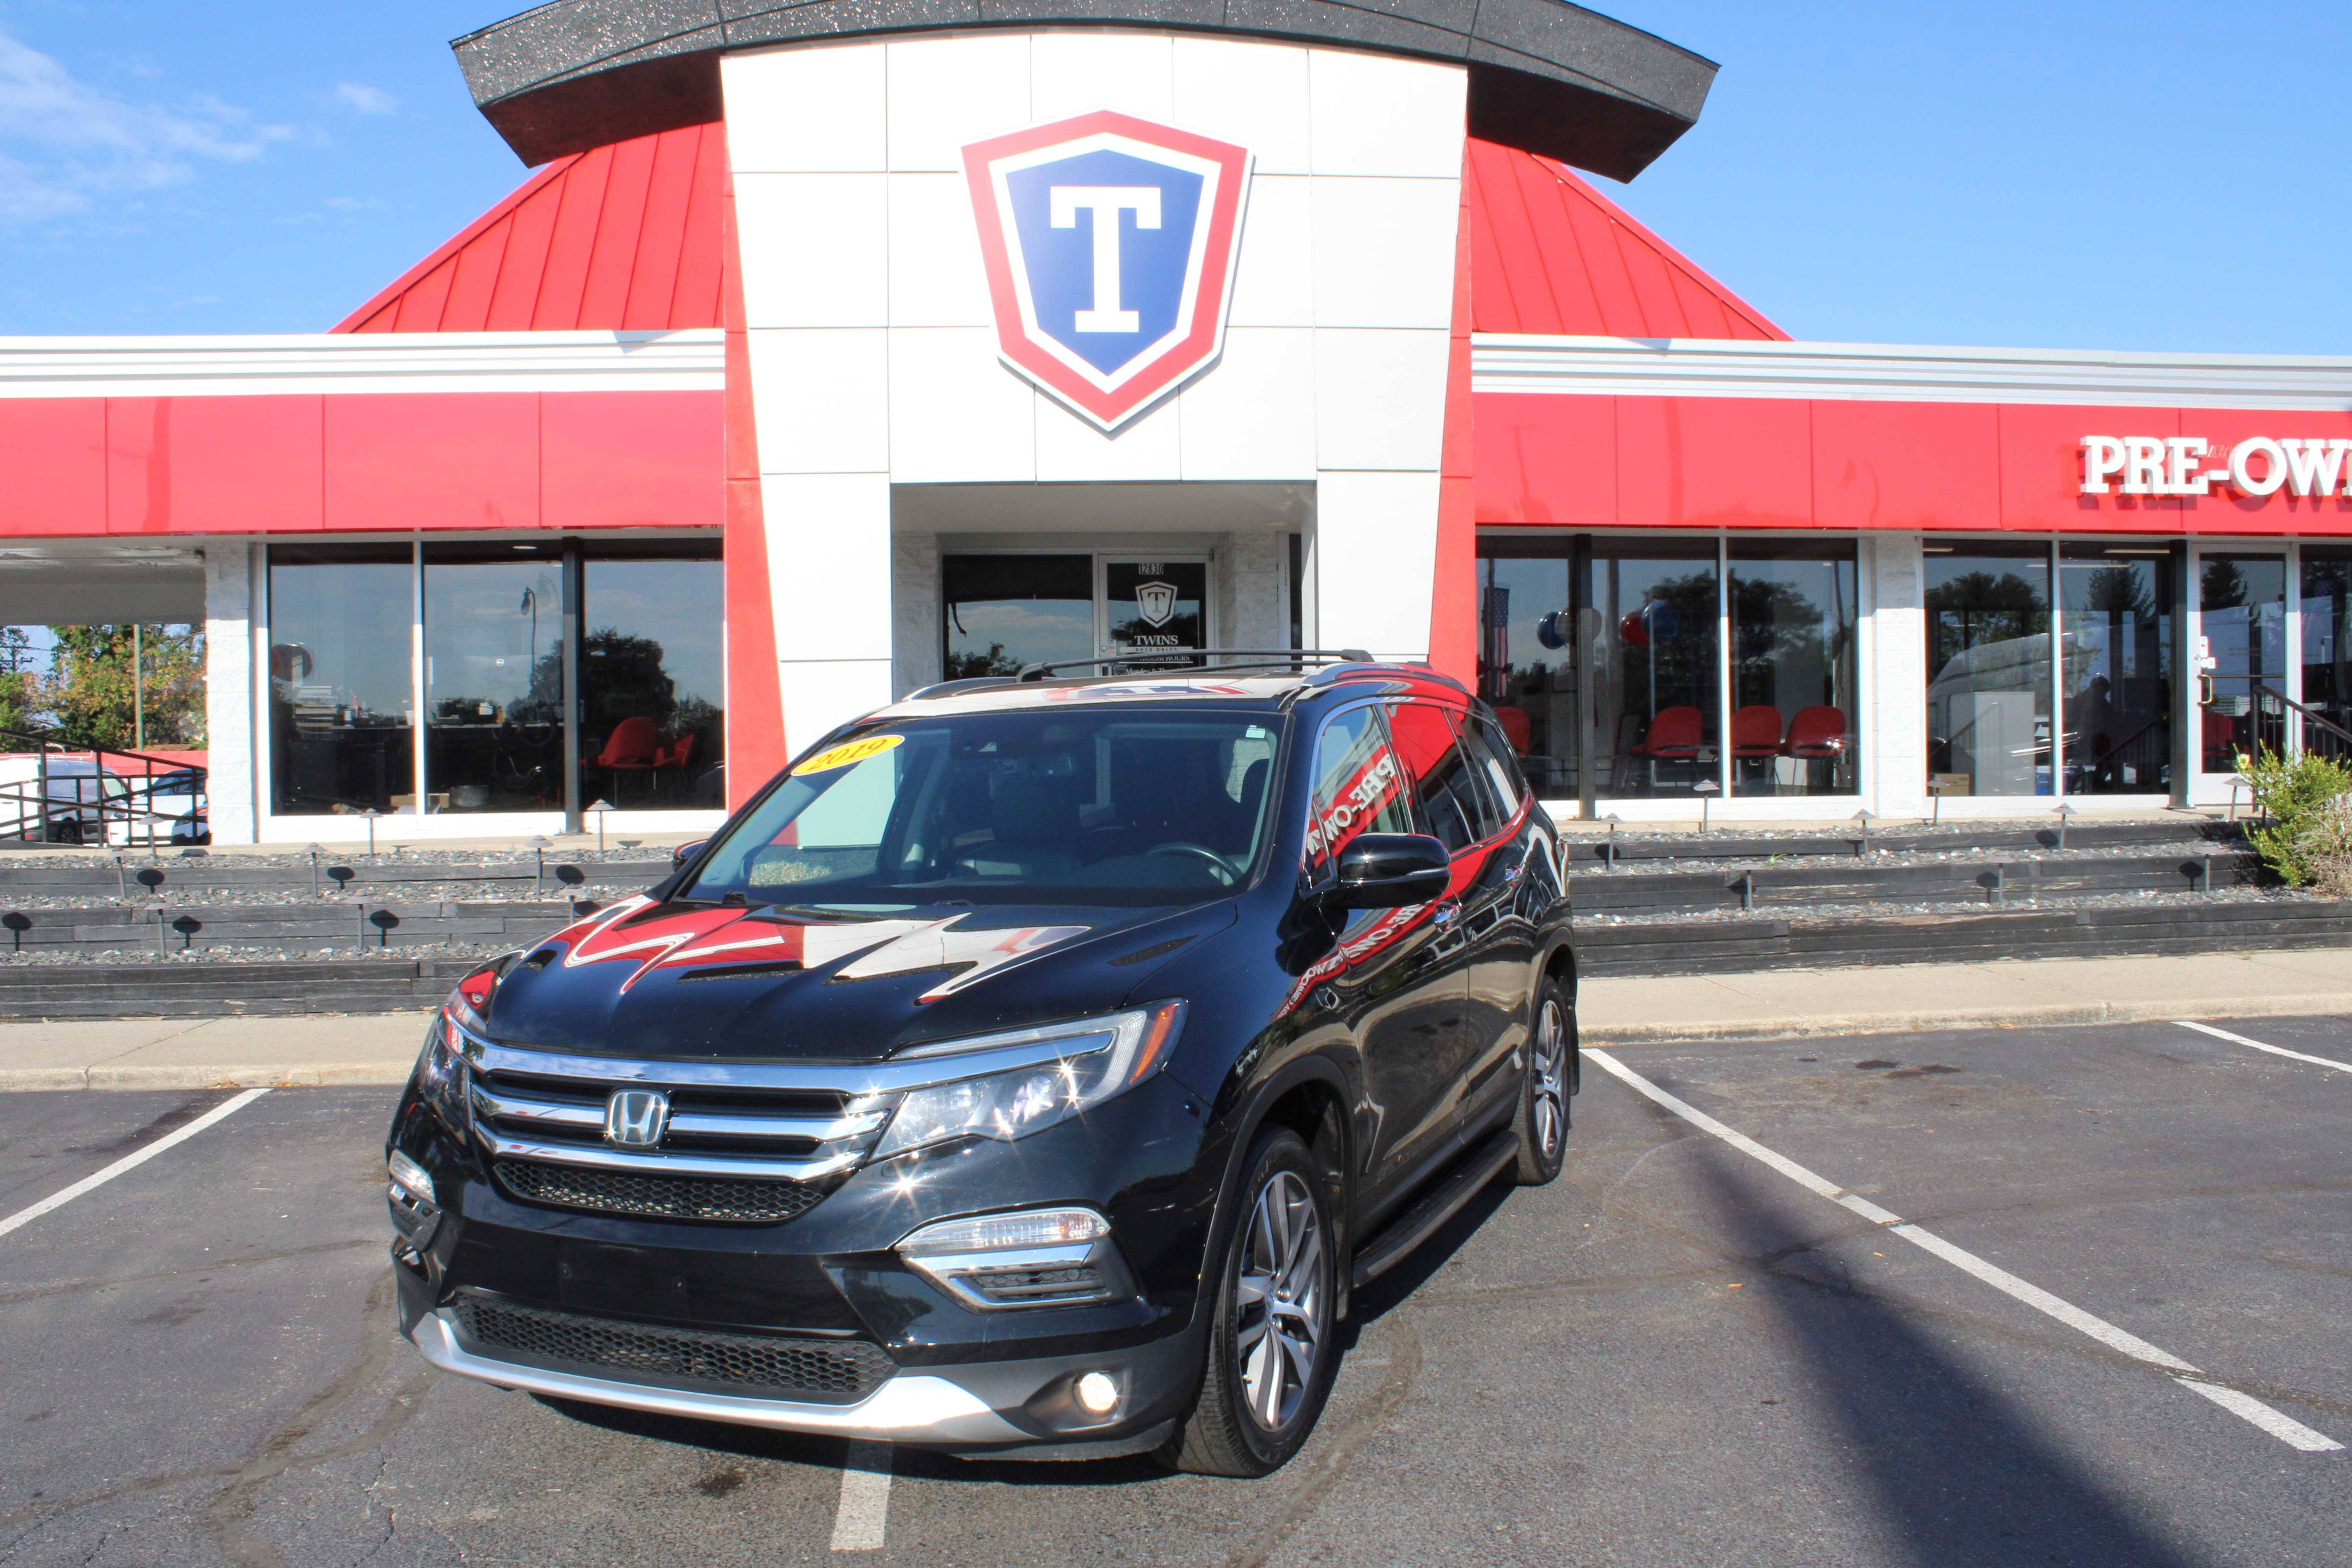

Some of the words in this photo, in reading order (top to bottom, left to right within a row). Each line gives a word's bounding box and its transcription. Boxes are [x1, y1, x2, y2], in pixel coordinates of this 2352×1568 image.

[1050, 186, 1161, 332] T
[1140, 564, 1163, 574] 12830
[1148, 592, 1165, 612] T
[1134, 635, 1178, 645] TWINS
[806, 739, 887, 771] 2019
